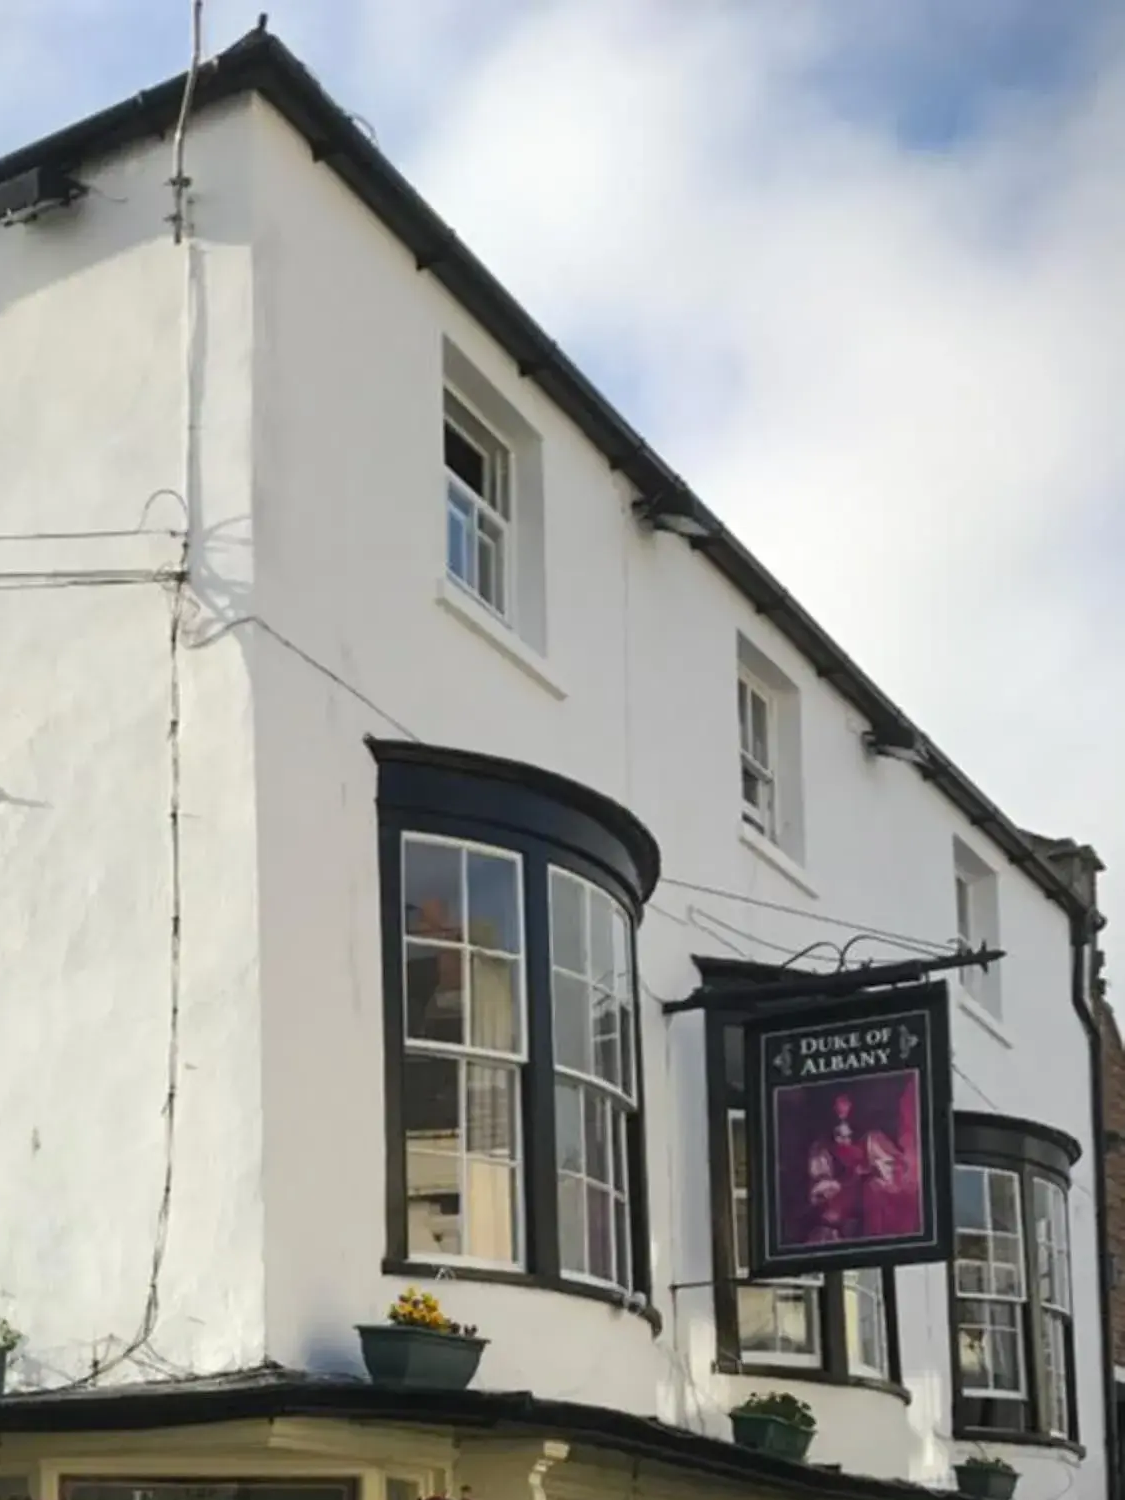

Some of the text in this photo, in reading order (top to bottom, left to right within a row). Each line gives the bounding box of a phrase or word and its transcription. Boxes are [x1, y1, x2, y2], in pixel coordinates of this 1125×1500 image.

[800, 1027, 892, 1055] DUKE OF
[800, 1047, 891, 1076] ALBANY
